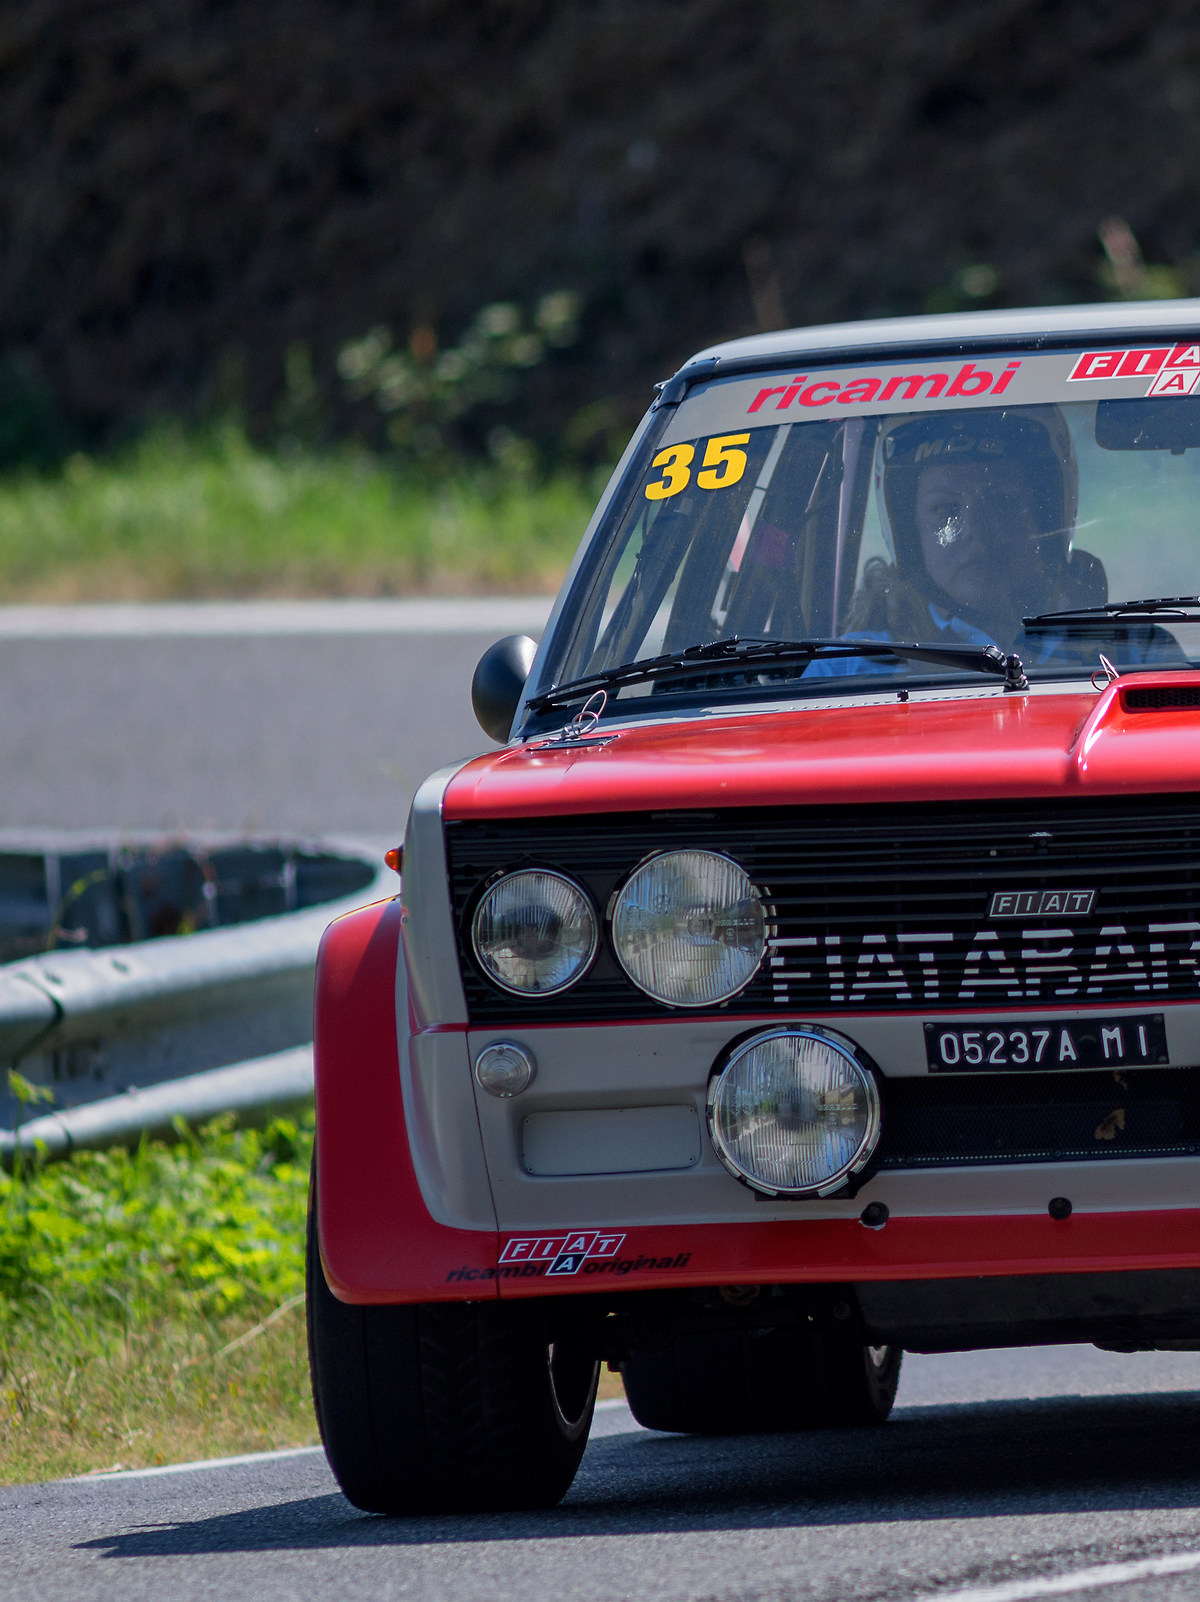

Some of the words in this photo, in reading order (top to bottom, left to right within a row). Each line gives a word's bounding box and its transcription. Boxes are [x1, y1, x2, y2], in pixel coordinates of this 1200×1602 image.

[746, 360, 1022, 414] ricambi
[1157, 373, 1186, 392] A
[644, 432, 751, 500] 35
[997, 893, 1090, 913] FIAT
[939, 1029, 1077, 1064] 05237A
[509, 1236, 616, 1258] FIAT
[445, 1262, 546, 1283] ricambi
[583, 1252, 692, 1276] originali
